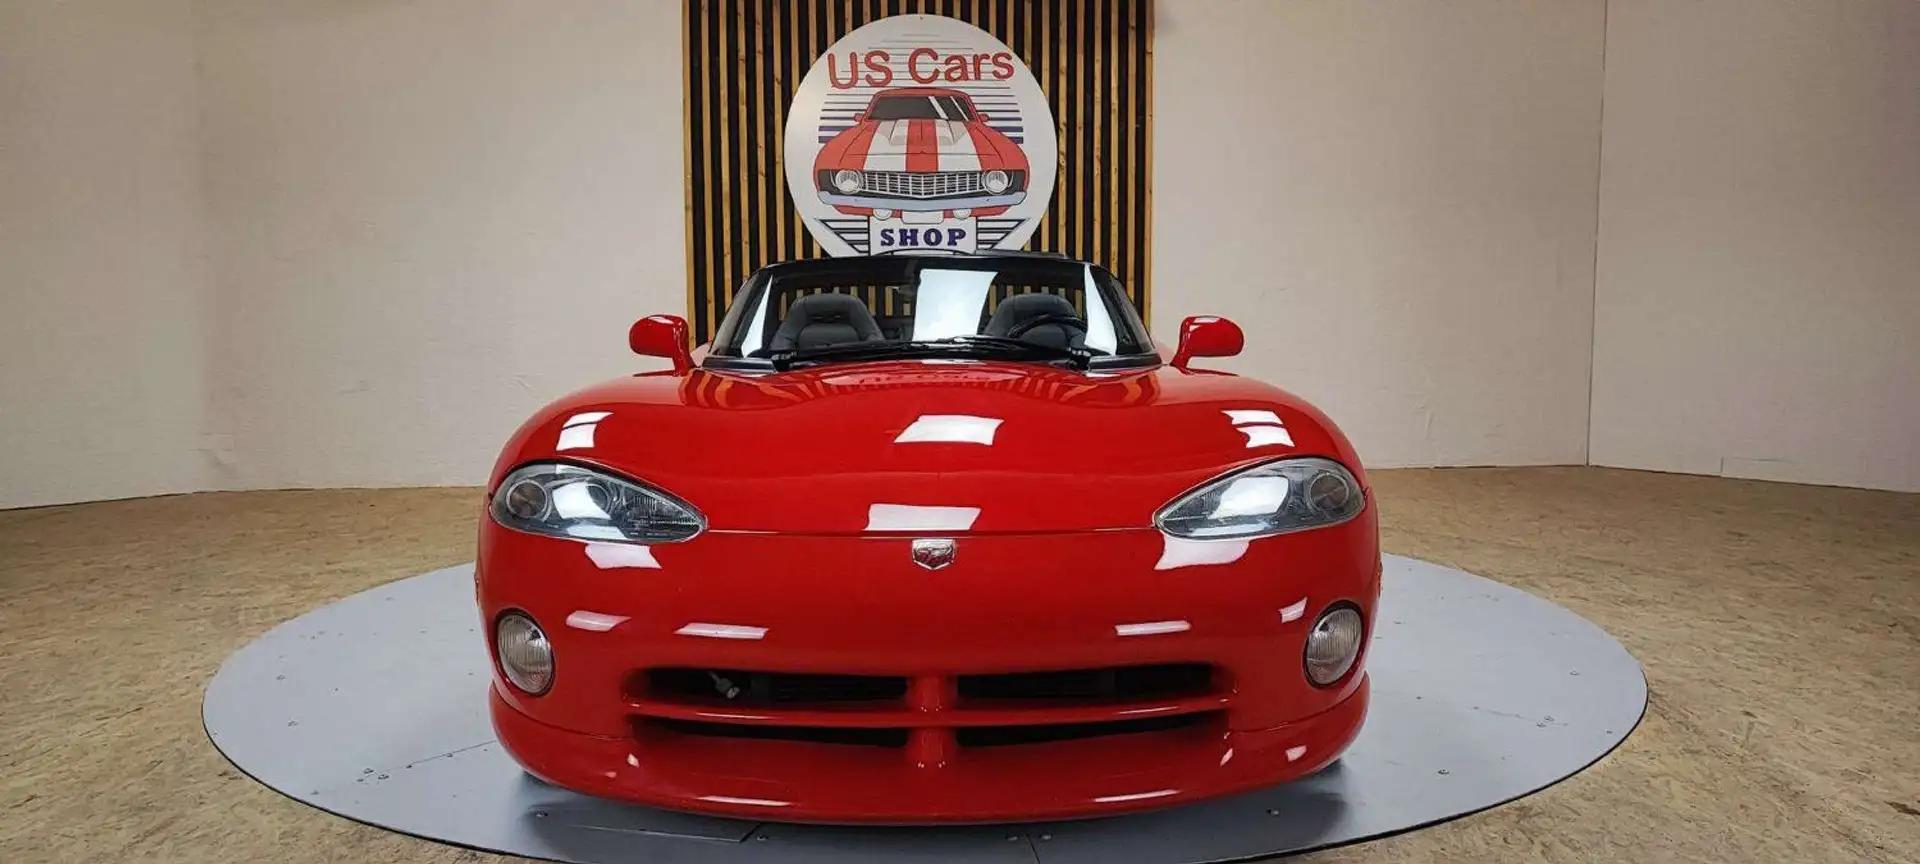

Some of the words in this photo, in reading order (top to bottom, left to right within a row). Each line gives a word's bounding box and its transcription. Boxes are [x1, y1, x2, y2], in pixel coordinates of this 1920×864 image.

[827, 51, 893, 89] US
[908, 48, 1015, 84] Cars
[880, 228, 967, 247] SHOP
